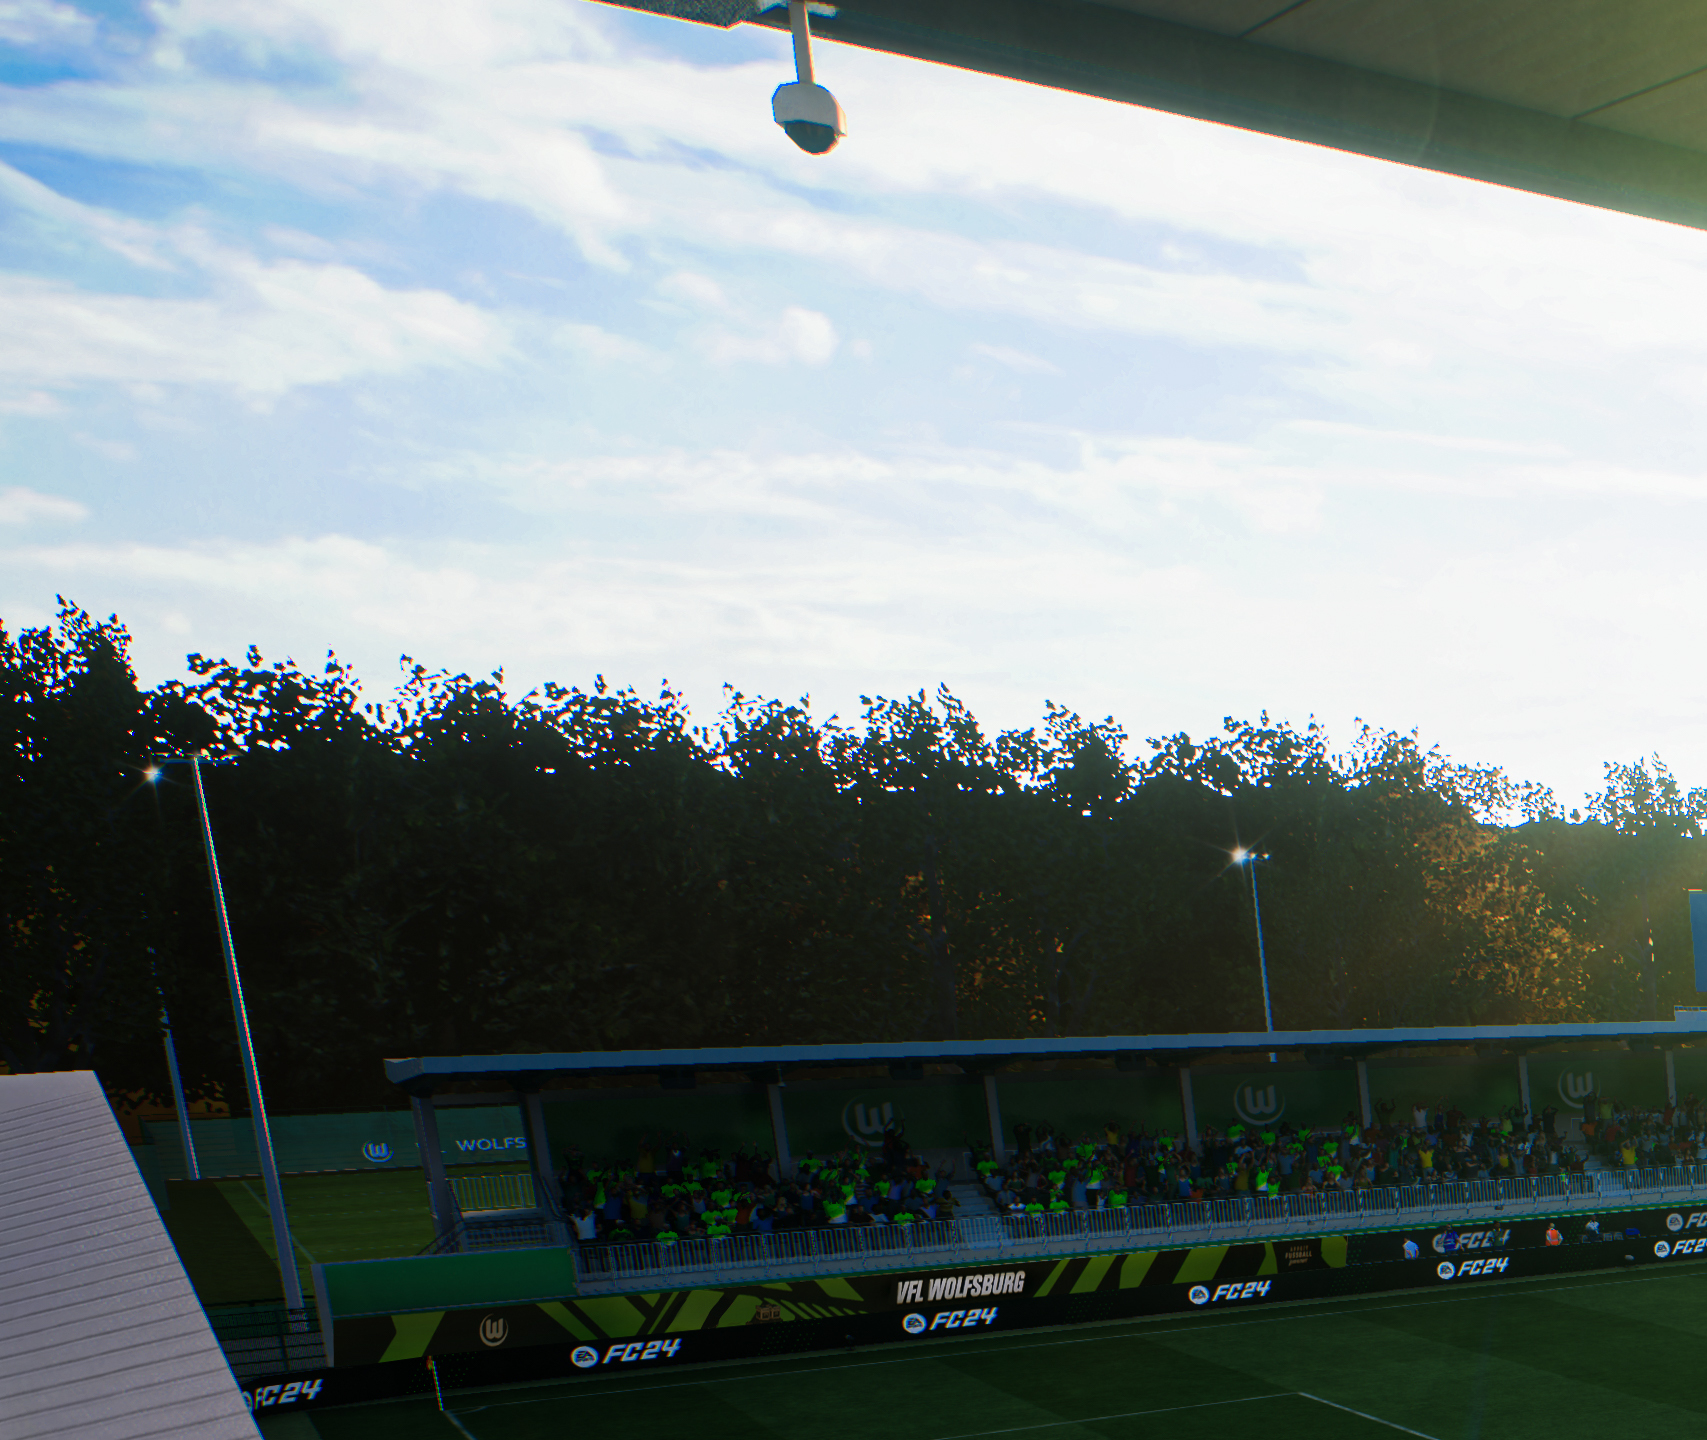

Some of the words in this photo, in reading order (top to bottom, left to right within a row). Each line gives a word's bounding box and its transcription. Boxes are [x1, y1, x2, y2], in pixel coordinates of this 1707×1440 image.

[1457, 1257, 1510, 1277] FC24
[896, 1279, 924, 1305] VFL
[927, 1270, 1026, 1302] WOLFSBURG
[1211, 1280, 1272, 1302] FC24
[929, 1307, 999, 1331] FC24
[601, 1338, 683, 1365] FC24
